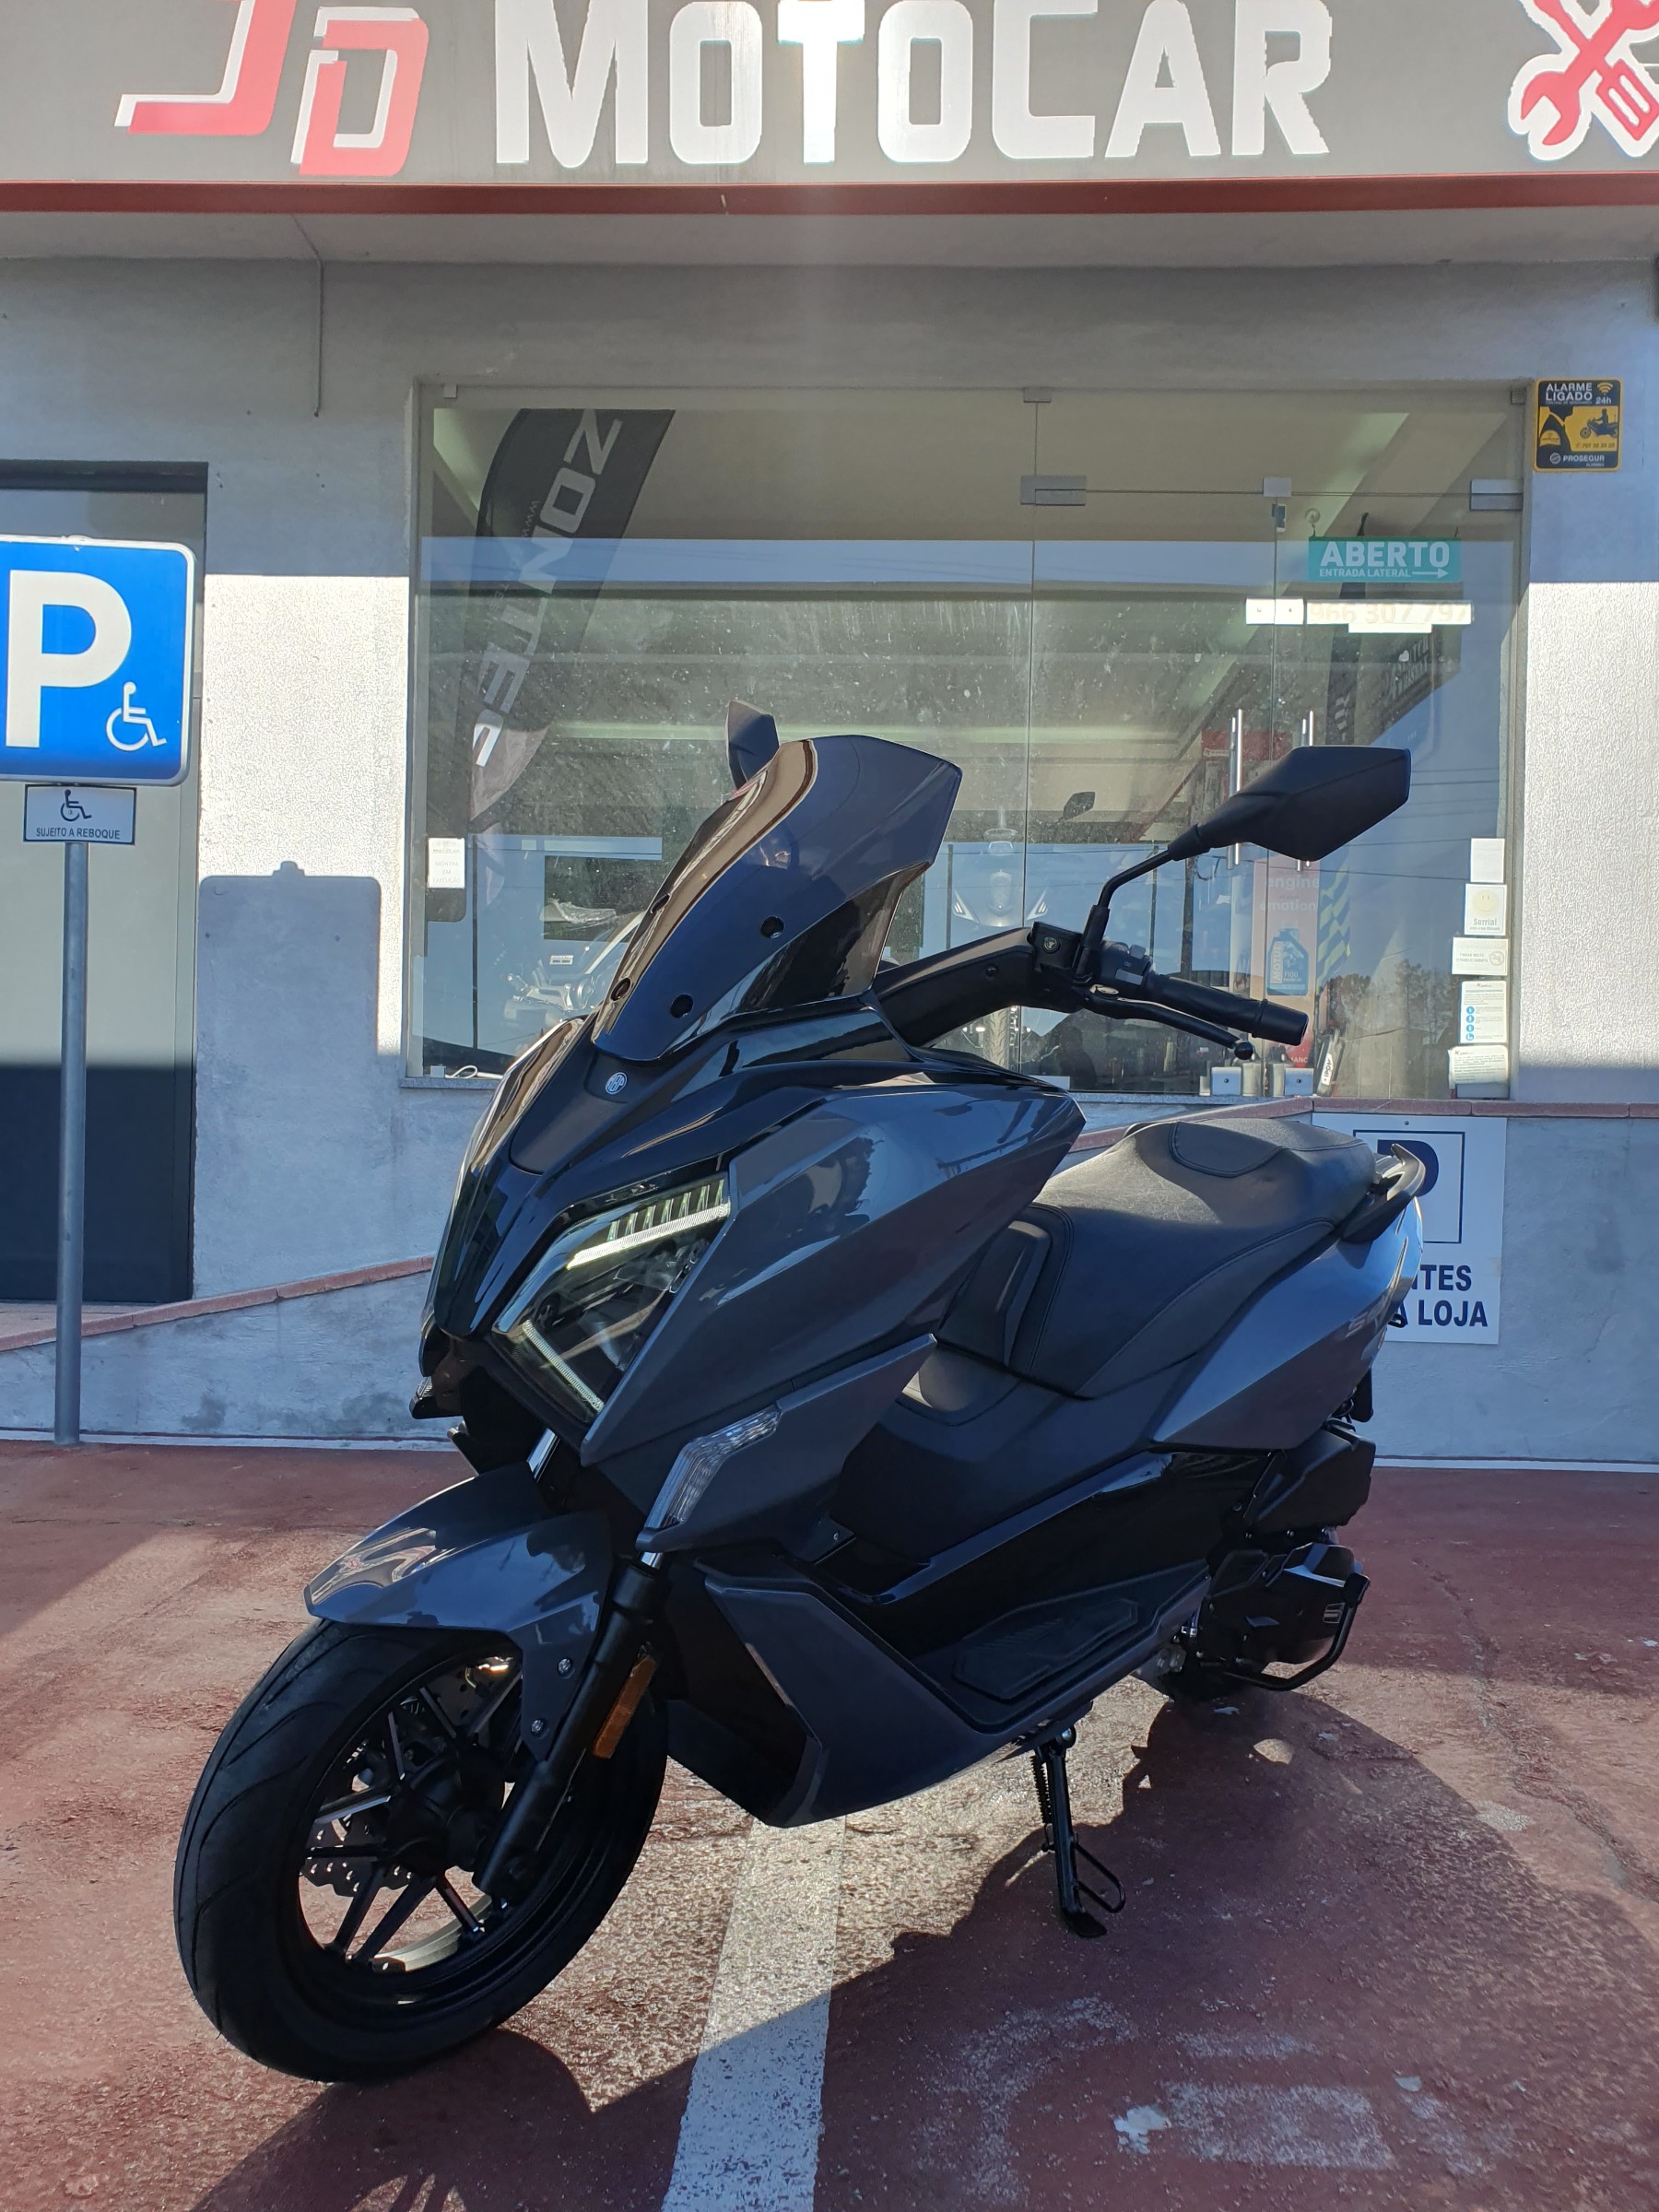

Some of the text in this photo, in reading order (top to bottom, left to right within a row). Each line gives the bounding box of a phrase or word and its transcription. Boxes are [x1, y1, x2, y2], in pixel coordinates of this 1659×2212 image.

[1546, 382, 1593, 392] ALARME
[1546, 392, 1593, 401] LIGADO
[1563, 454, 1605, 463] PROSEGUR
[1320, 541, 1450, 568] ABERTO
[1319, 568, 1411, 578] ENTRADA LATERAL
[6, 569, 132, 748] P
[36, 827, 121, 840] SUJEITO A REBOQUE
[1418, 1300, 1488, 1327] LOJA
